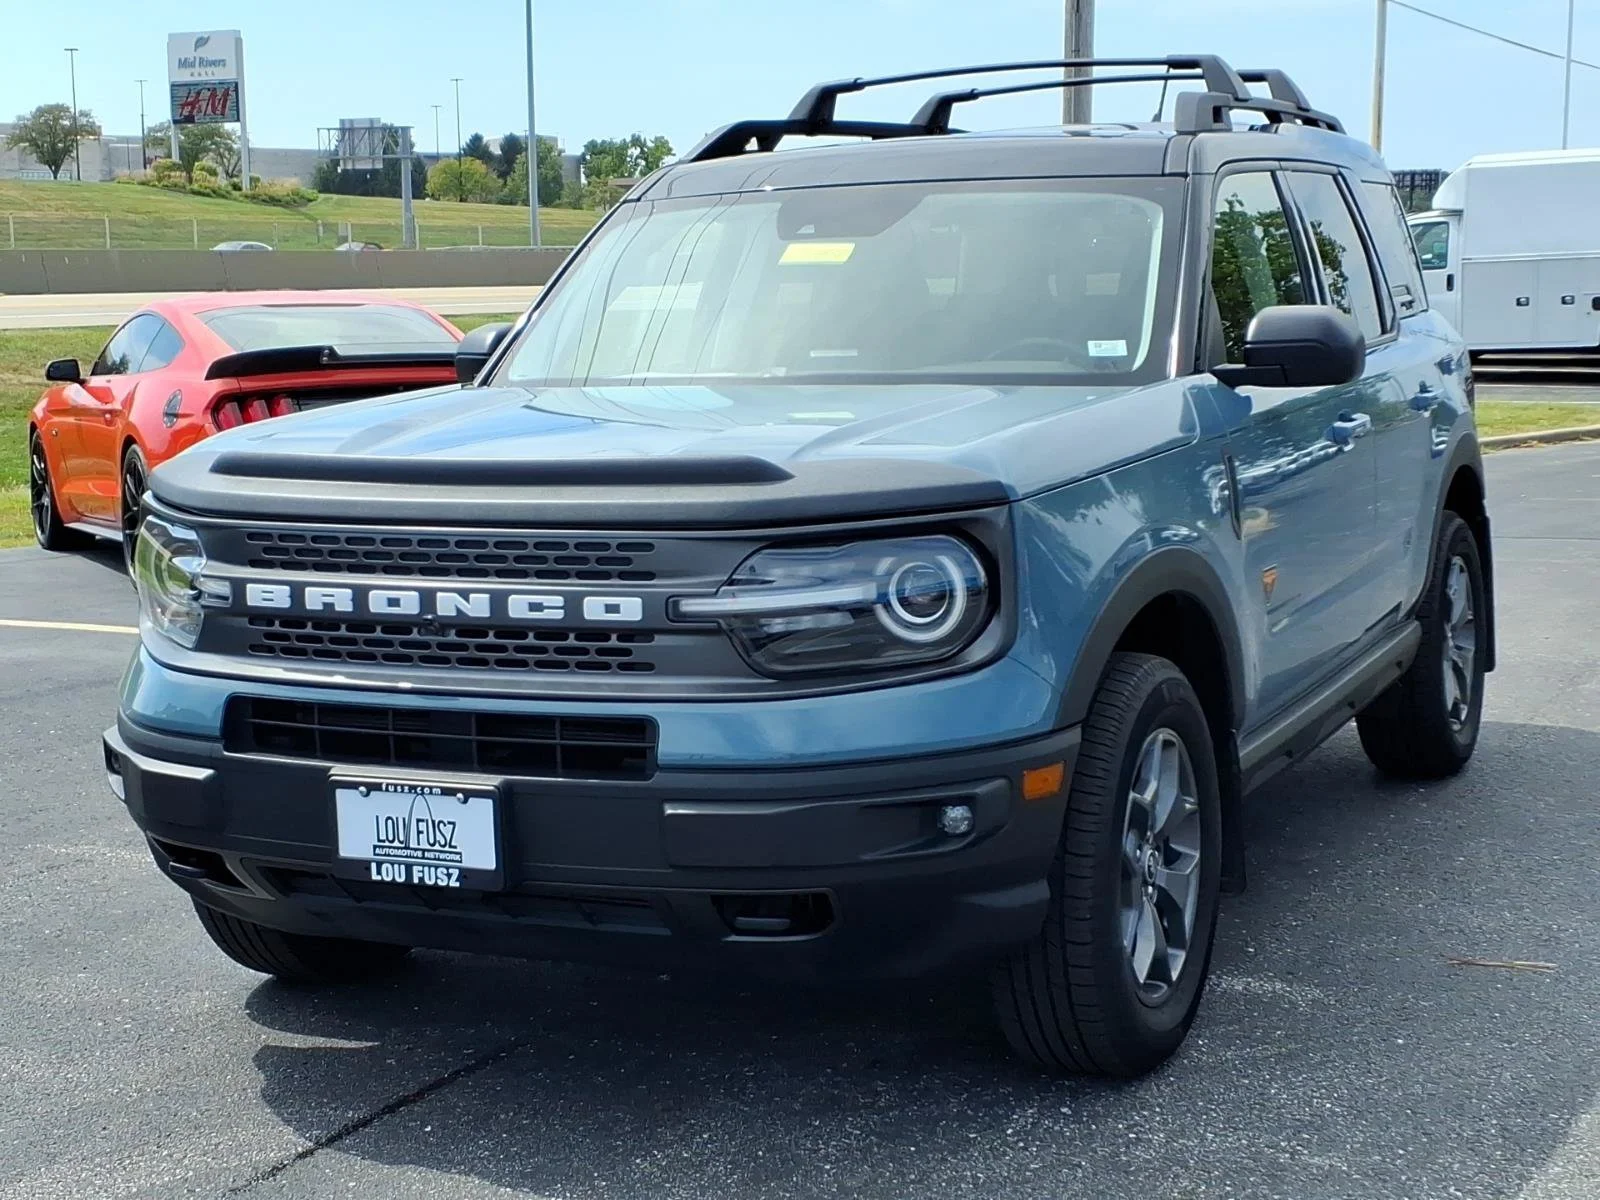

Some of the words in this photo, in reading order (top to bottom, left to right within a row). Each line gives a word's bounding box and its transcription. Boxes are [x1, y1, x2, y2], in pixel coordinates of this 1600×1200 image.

[178, 56, 196, 69] Mid
[199, 55, 226, 68] Rivers
[245, 583, 643, 621] BRONCO
[382, 783, 442, 795] fusz.com
[376, 815, 406, 845] LOU
[415, 818, 458, 849] FUSZ
[375, 847, 423, 858] AUTOMOTIVE
[424, 850, 462, 861] NETWORK
[370, 862, 406, 882] LOU
[412, 865, 460, 887] FUSZ
